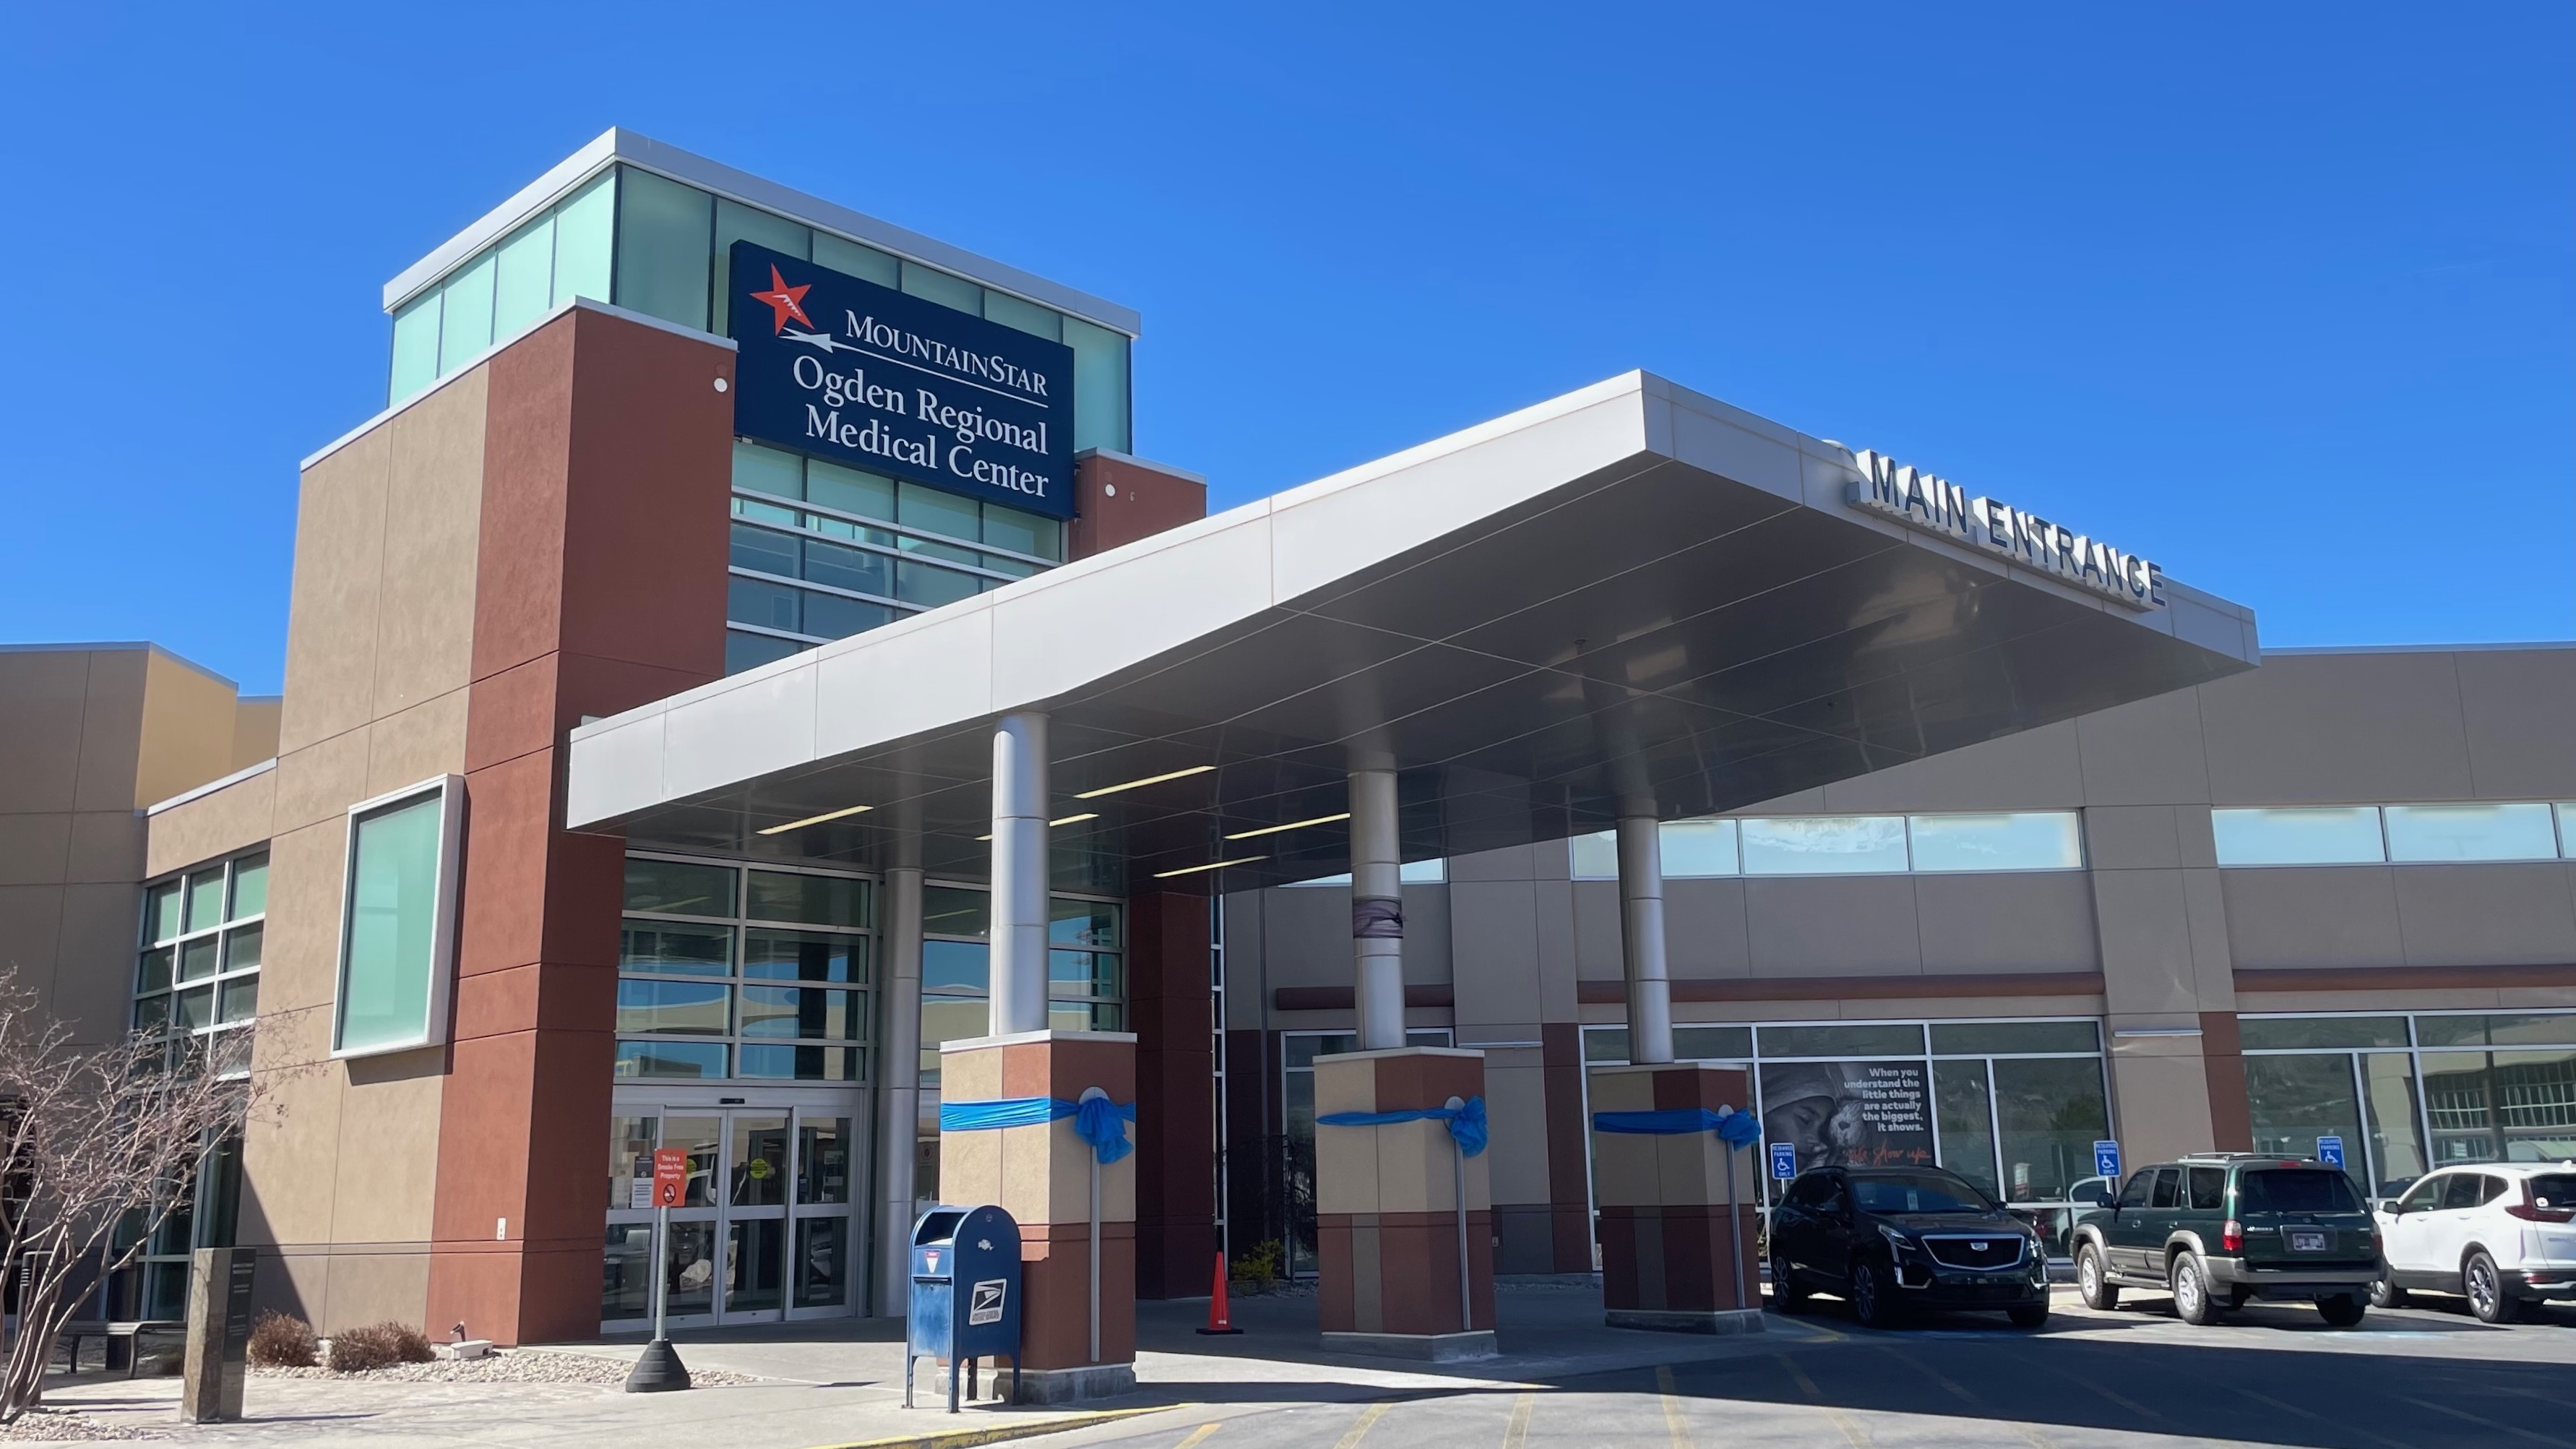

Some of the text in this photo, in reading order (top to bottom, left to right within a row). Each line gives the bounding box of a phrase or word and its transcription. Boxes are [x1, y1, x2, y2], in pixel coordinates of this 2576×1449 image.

[794, 356, 1048, 455] Ogden Regional
[806, 403, 1048, 497] Medical Center
[1860, 449, 2166, 607] MAIN ENTRANCE
[1869, 1067, 1918, 1078] When you
[1844, 1078, 1920, 1088] understand the
[1862, 1089, 1921, 1100] little things
[1882, 1101, 1921, 1112] actually
[1862, 1112, 1879, 1121] the
[1888, 1121, 1924, 1132] shows.
